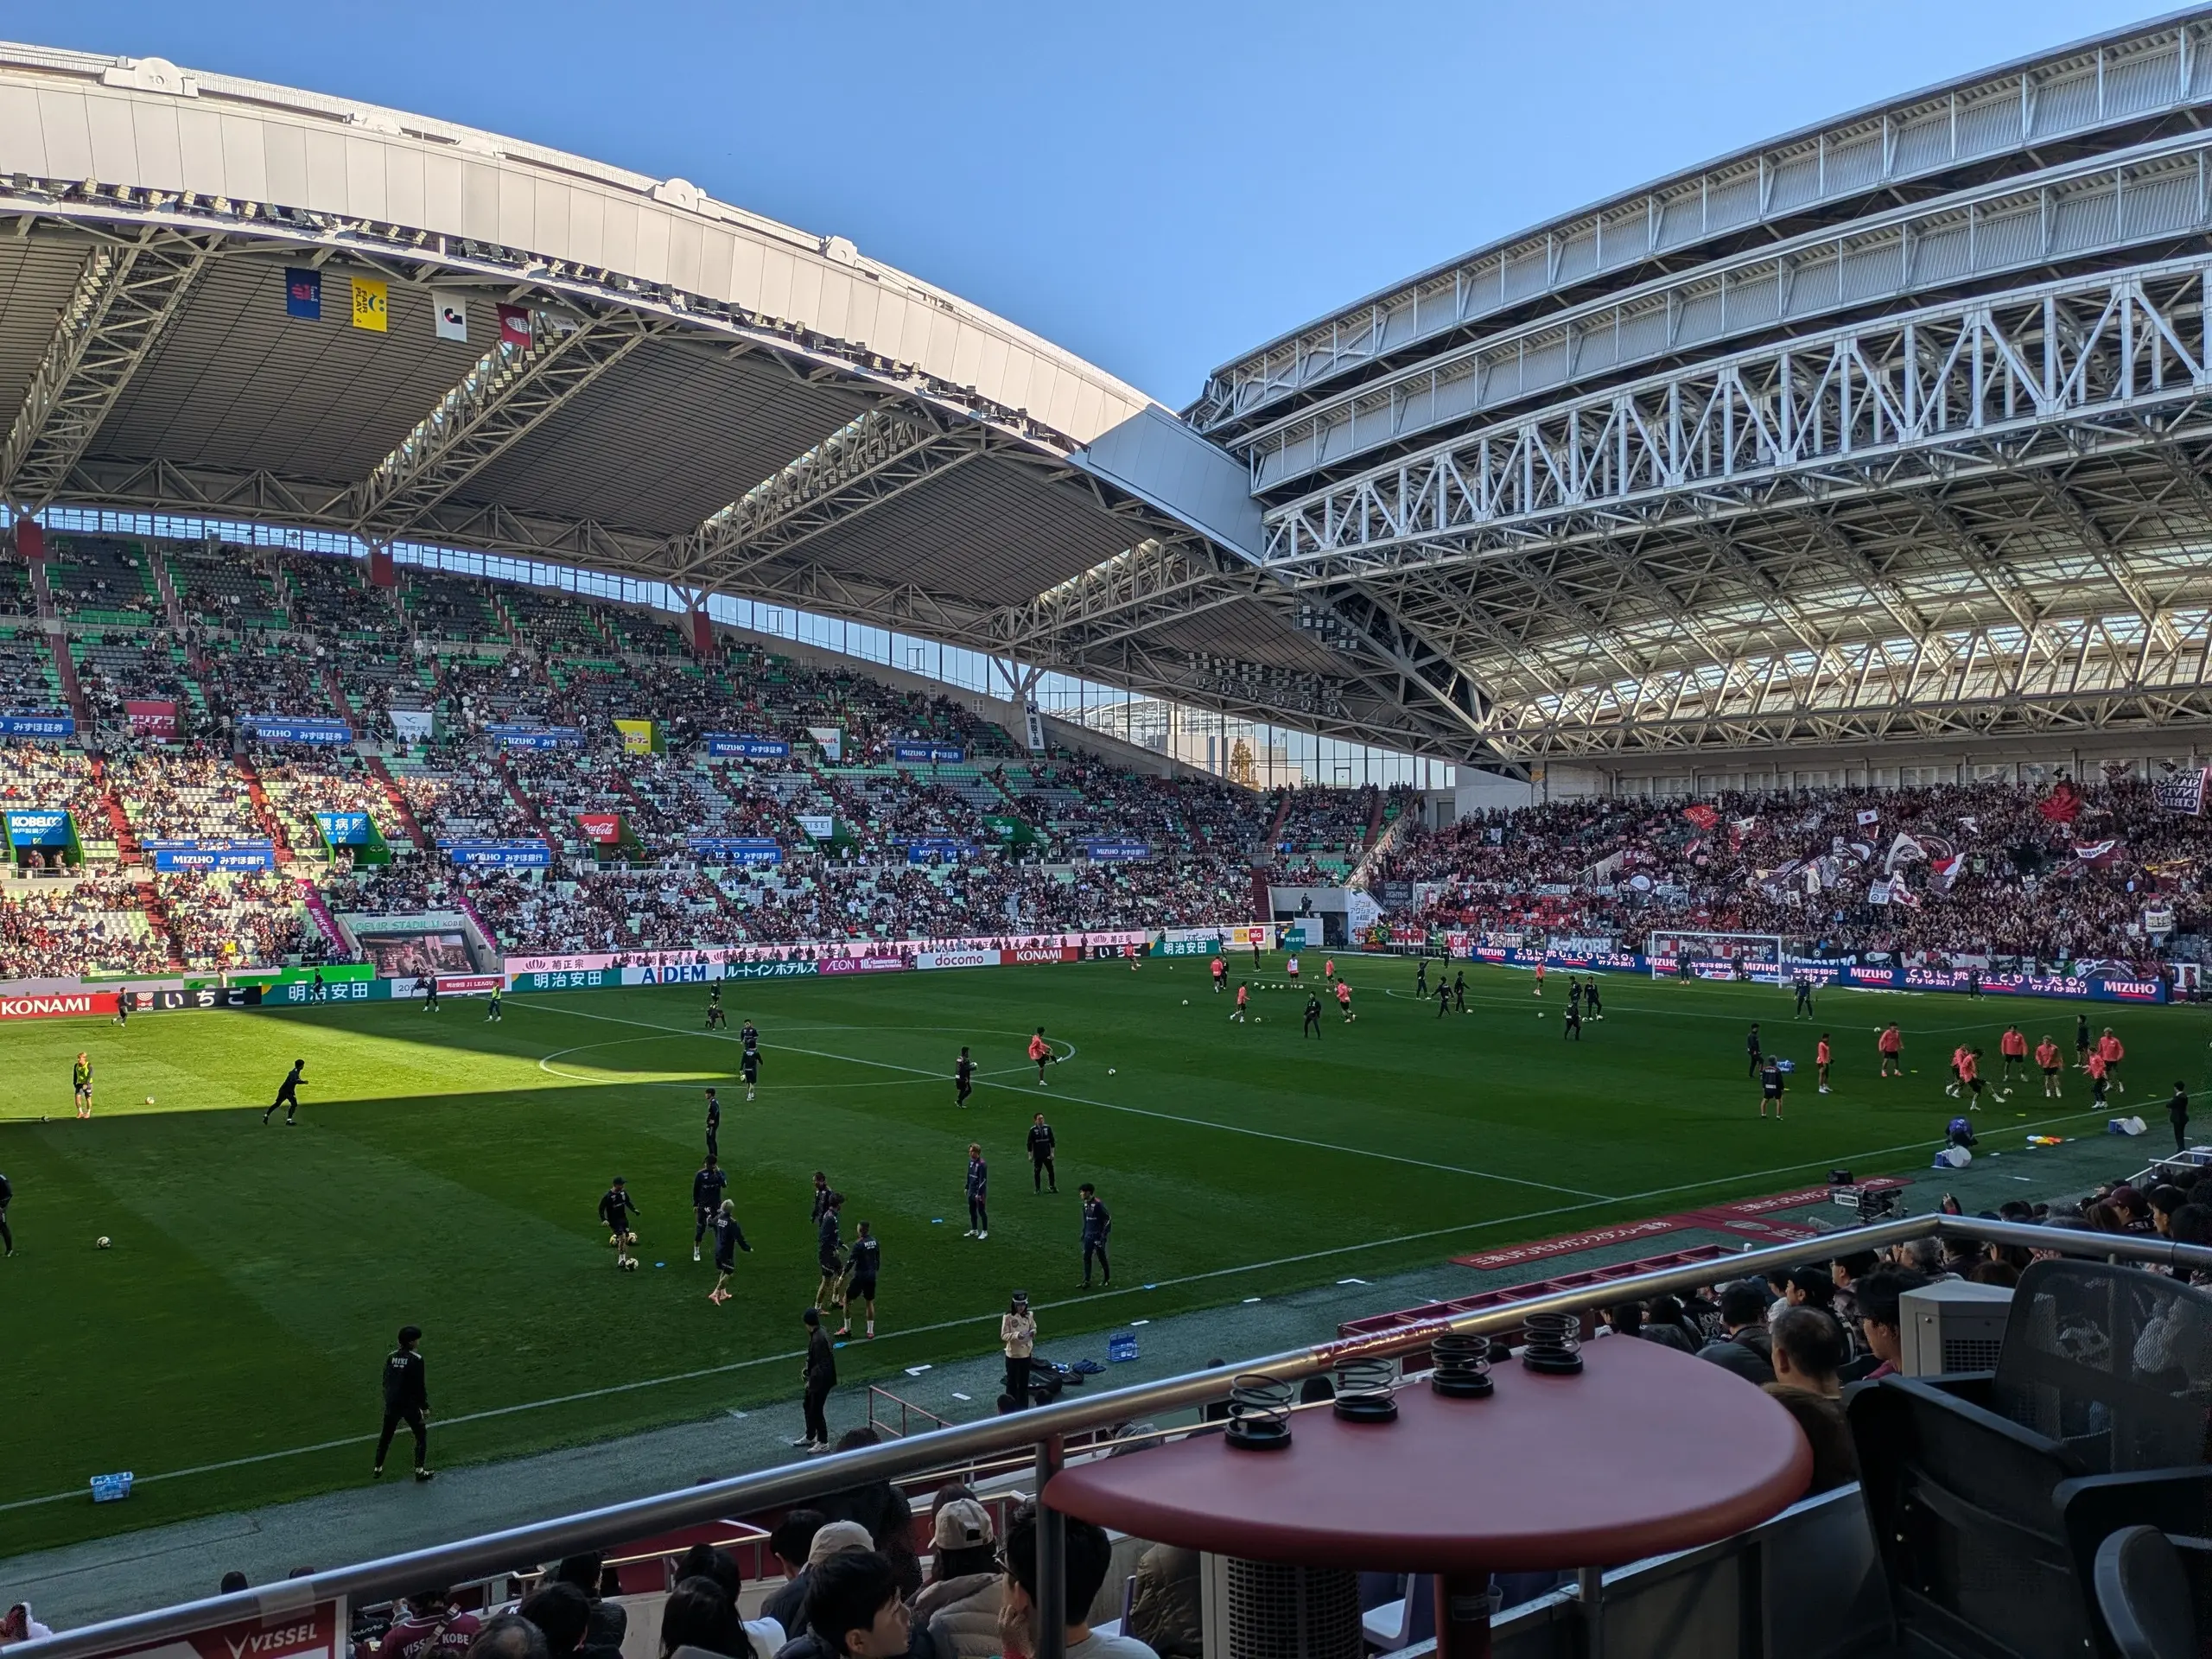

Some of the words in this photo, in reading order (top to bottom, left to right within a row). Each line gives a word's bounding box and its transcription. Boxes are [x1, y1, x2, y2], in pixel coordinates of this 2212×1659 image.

[13, 721, 63, 733] みずほ証券
[300, 731, 342, 741] みずほ証券
[716, 743, 746, 752] MIZUHO
[751, 745, 783, 754] みずほ証券
[11, 816, 63, 827] KOBELCO
[173, 855, 214, 864] MIZUHO
[219, 856, 265, 865] みずほ銀行
[392, 919, 439, 930] STADIUM
[1164, 941, 1207, 955] 明治安田
[1477, 947, 1506, 957] MIZUHO
[935, 953, 984, 967] docomo
[1016, 950, 1062, 962] KONAMI
[552, 958, 584, 969] 菊正宗
[727, 962, 818, 978] ルートインホテルズ
[1850, 967, 1893, 979] MIZUHO
[534, 970, 602, 988] 明治安田
[2104, 981, 2157, 994] MIZUHO
[164, 988, 246, 1009] いちご
[2, 997, 90, 1015] KONAMI
[251, 1624, 317, 1652] VISSEL
[403, 1636, 439, 1657] VISS
[442, 1632, 469, 1646] KOBE
